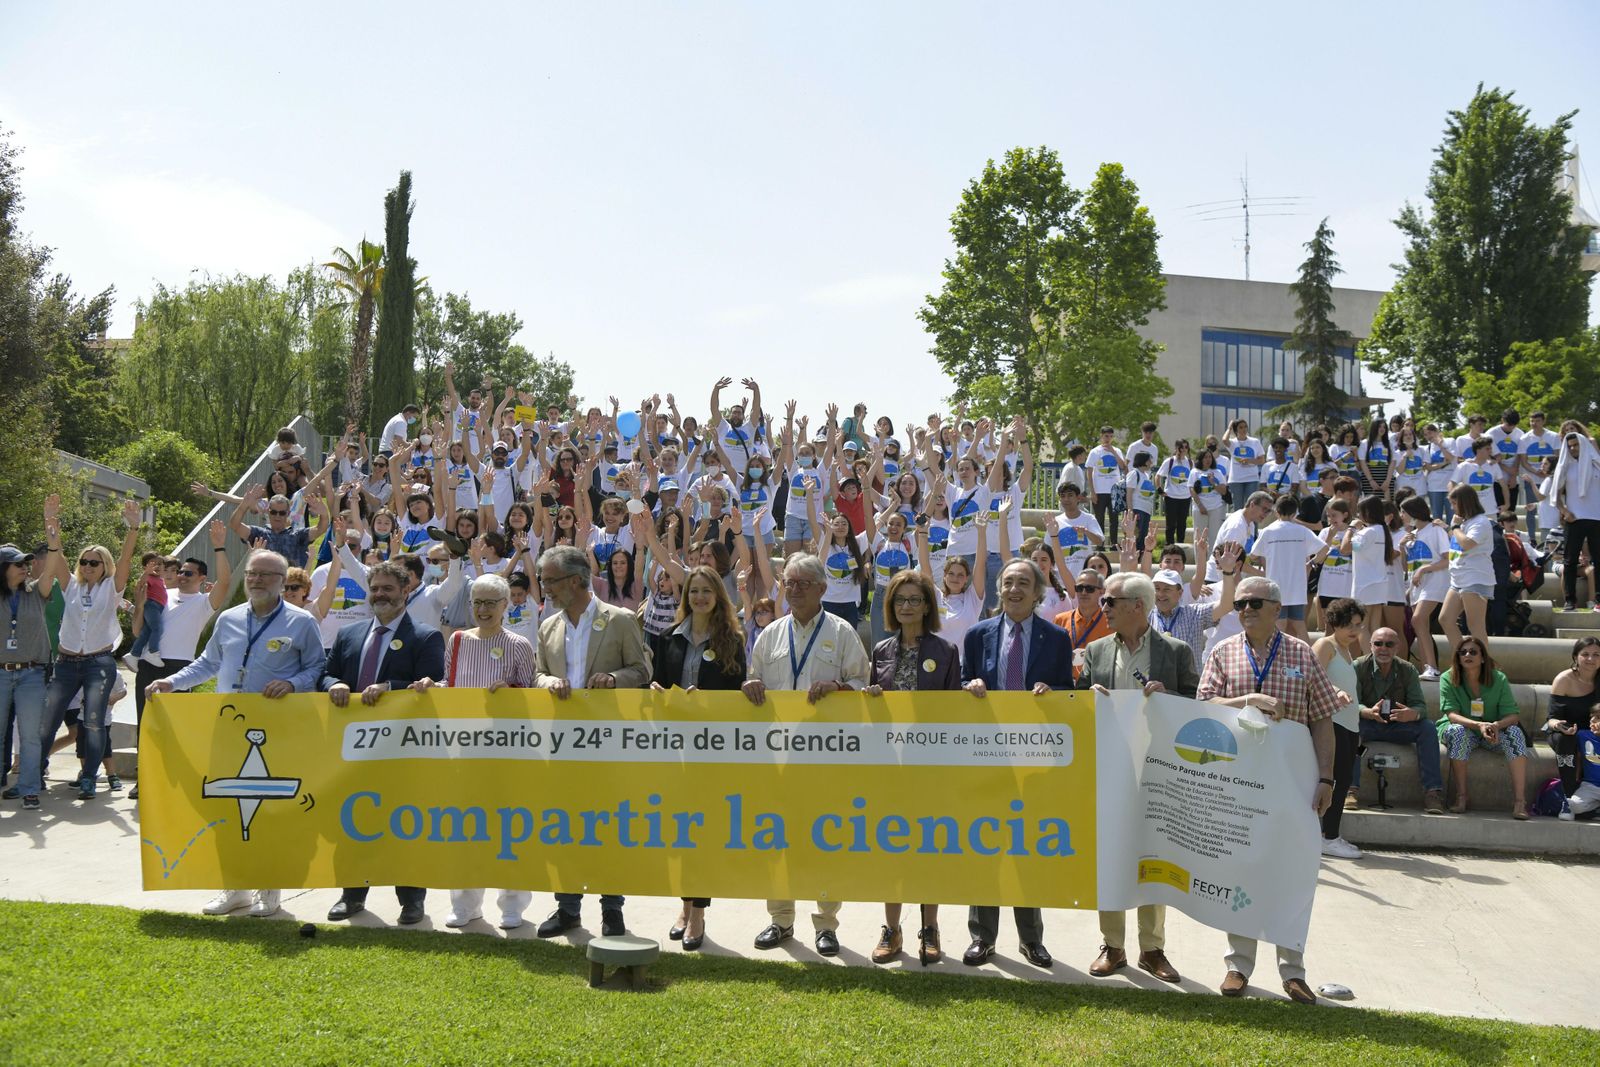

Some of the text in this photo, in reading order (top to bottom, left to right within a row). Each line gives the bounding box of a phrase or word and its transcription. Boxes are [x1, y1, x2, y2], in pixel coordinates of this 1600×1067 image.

[400, 724, 542, 748] Aniversario
[550, 731, 565, 755] y
[572, 727, 613, 749] 24ª
[622, 727, 684, 750] Feria
[693, 727, 725, 751] de
[735, 727, 756, 751] la
[765, 728, 861, 752] Ciencia
[886, 731, 1064, 746] PARQUE de las CIENCIAS
[1145, 756, 1265, 790] Consorcio Parque de las Ciencias
[1204, 796, 1235, 809] Conocimiento
[1239, 804, 1269, 816] Universidades
[1208, 804, 1241, 816] Administración
[1241, 810, 1254, 819] Local
[340, 791, 1076, 861] Compartir la ciencia
[1186, 826, 1223, 841] INVESTIGACIONES
[1200, 837, 1225, 847] GRANADA
[1196, 848, 1219, 859] GRANADA
[1209, 845, 1232, 856] GRANADA
[1192, 878, 1233, 899] FECYT
